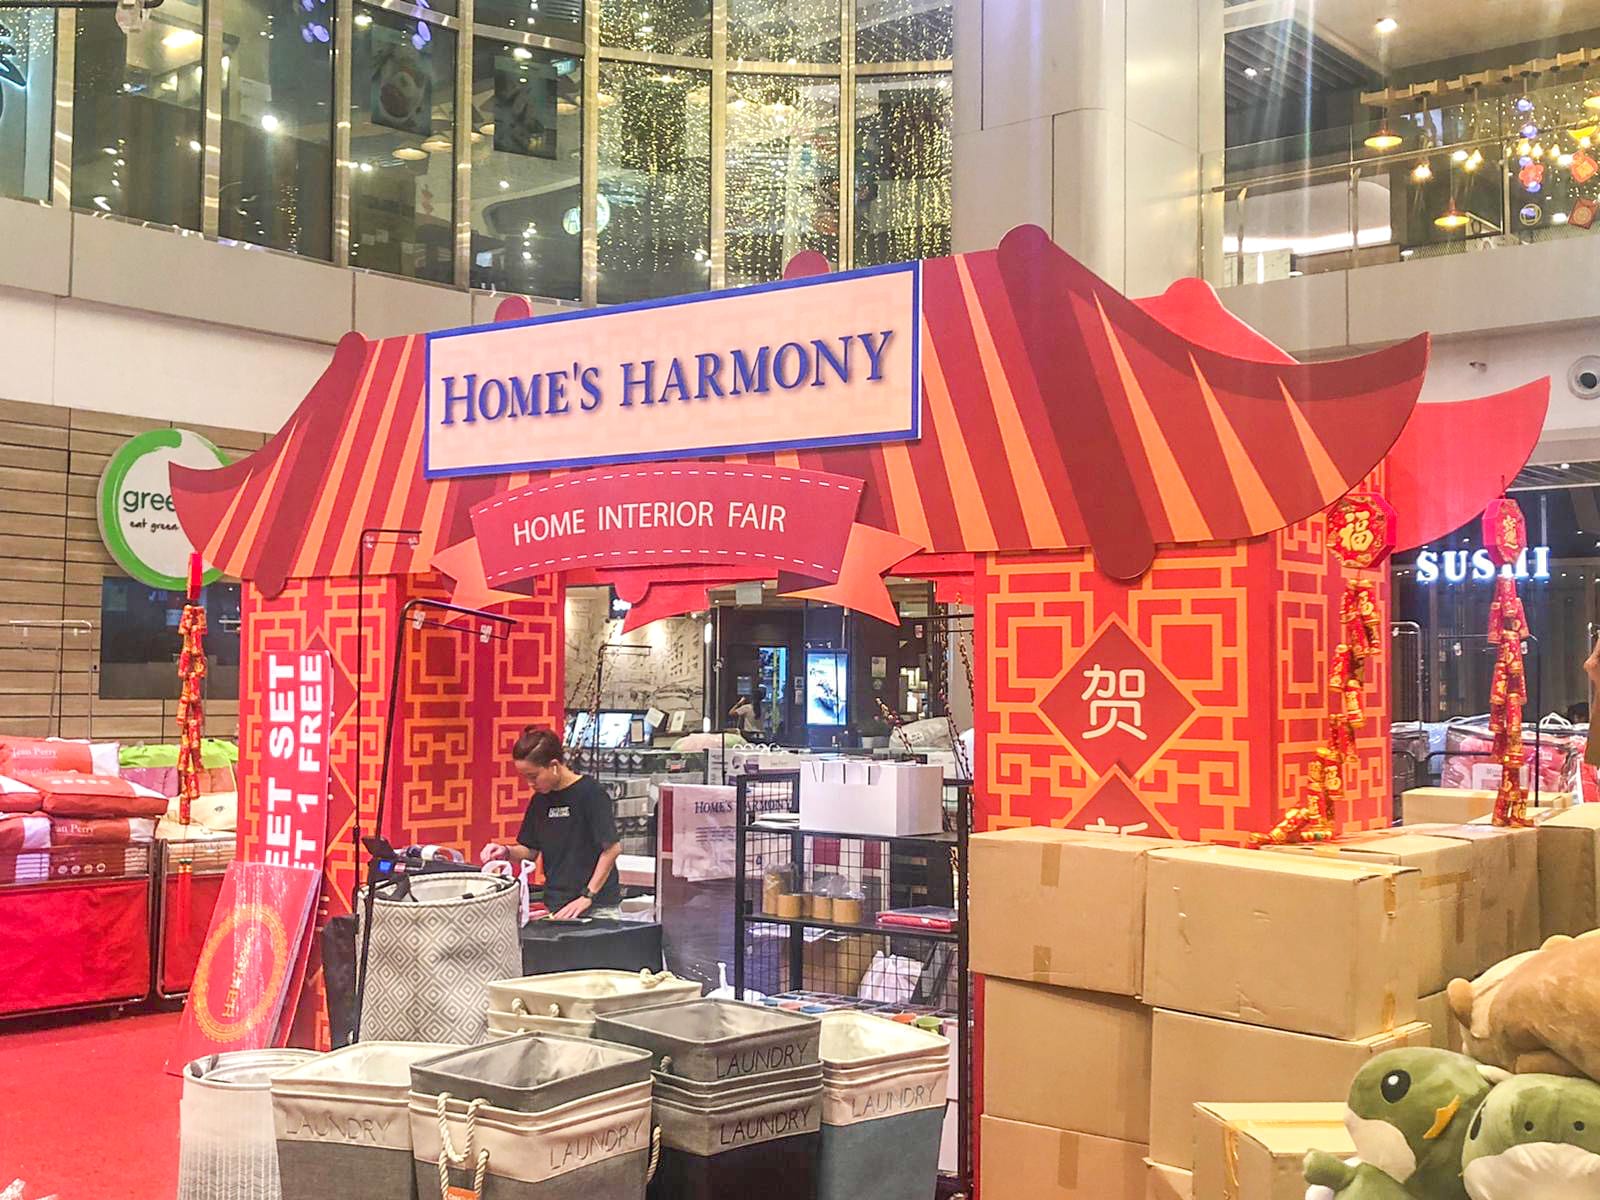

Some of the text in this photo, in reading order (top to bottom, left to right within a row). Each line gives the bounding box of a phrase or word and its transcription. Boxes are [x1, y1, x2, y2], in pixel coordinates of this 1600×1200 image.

[441, 331, 893, 425] HOME'S HARMONY
[130, 519, 147, 528] eat
[513, 501, 786, 546] HOME INTERIOR FAIR
[1339, 511, 1374, 551] 福
[269, 655, 295, 760] SET
[298, 655, 323, 772] FREE
[1081, 664, 1148, 740] 贺
[297, 794, 319, 813] 1
[695, 800, 793, 814] HOME'S ARMONY
[716, 1043, 809, 1080] LAUNDRY
[852, 1078, 938, 1118] LAUNDRY
[286, 1115, 392, 1142] LAUNDRY
[550, 1119, 643, 1170] LAUNDRY
[720, 1107, 813, 1145] LAUNDRY
